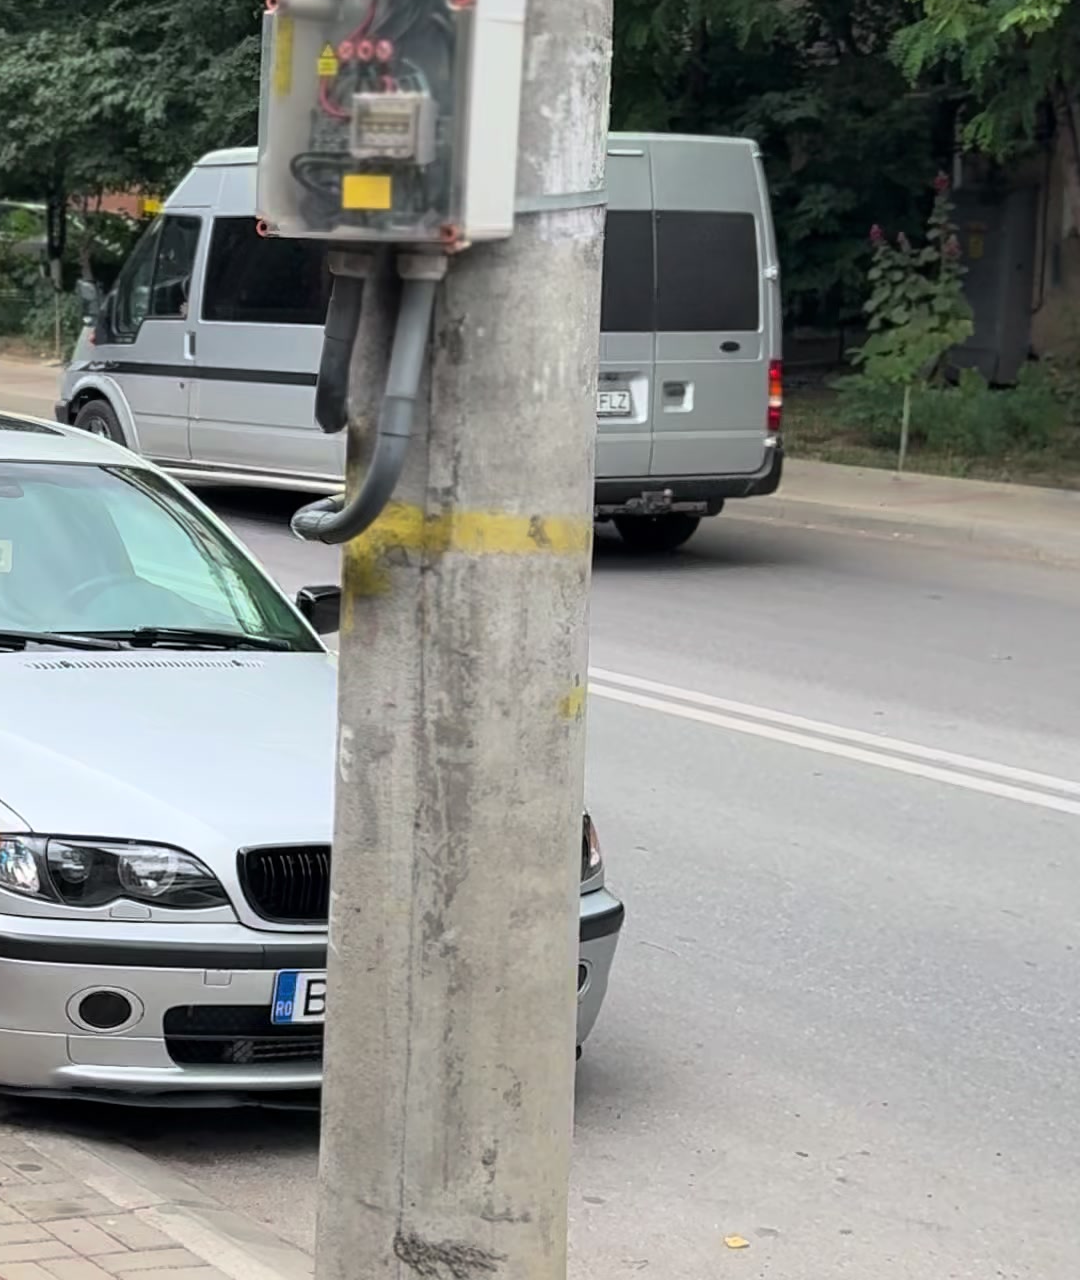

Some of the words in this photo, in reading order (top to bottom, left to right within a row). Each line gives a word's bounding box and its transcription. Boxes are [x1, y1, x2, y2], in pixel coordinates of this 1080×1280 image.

[599, 393, 628, 410] FLZ
[275, 1000, 293, 1017] RO
[303, 978, 326, 1016] B
